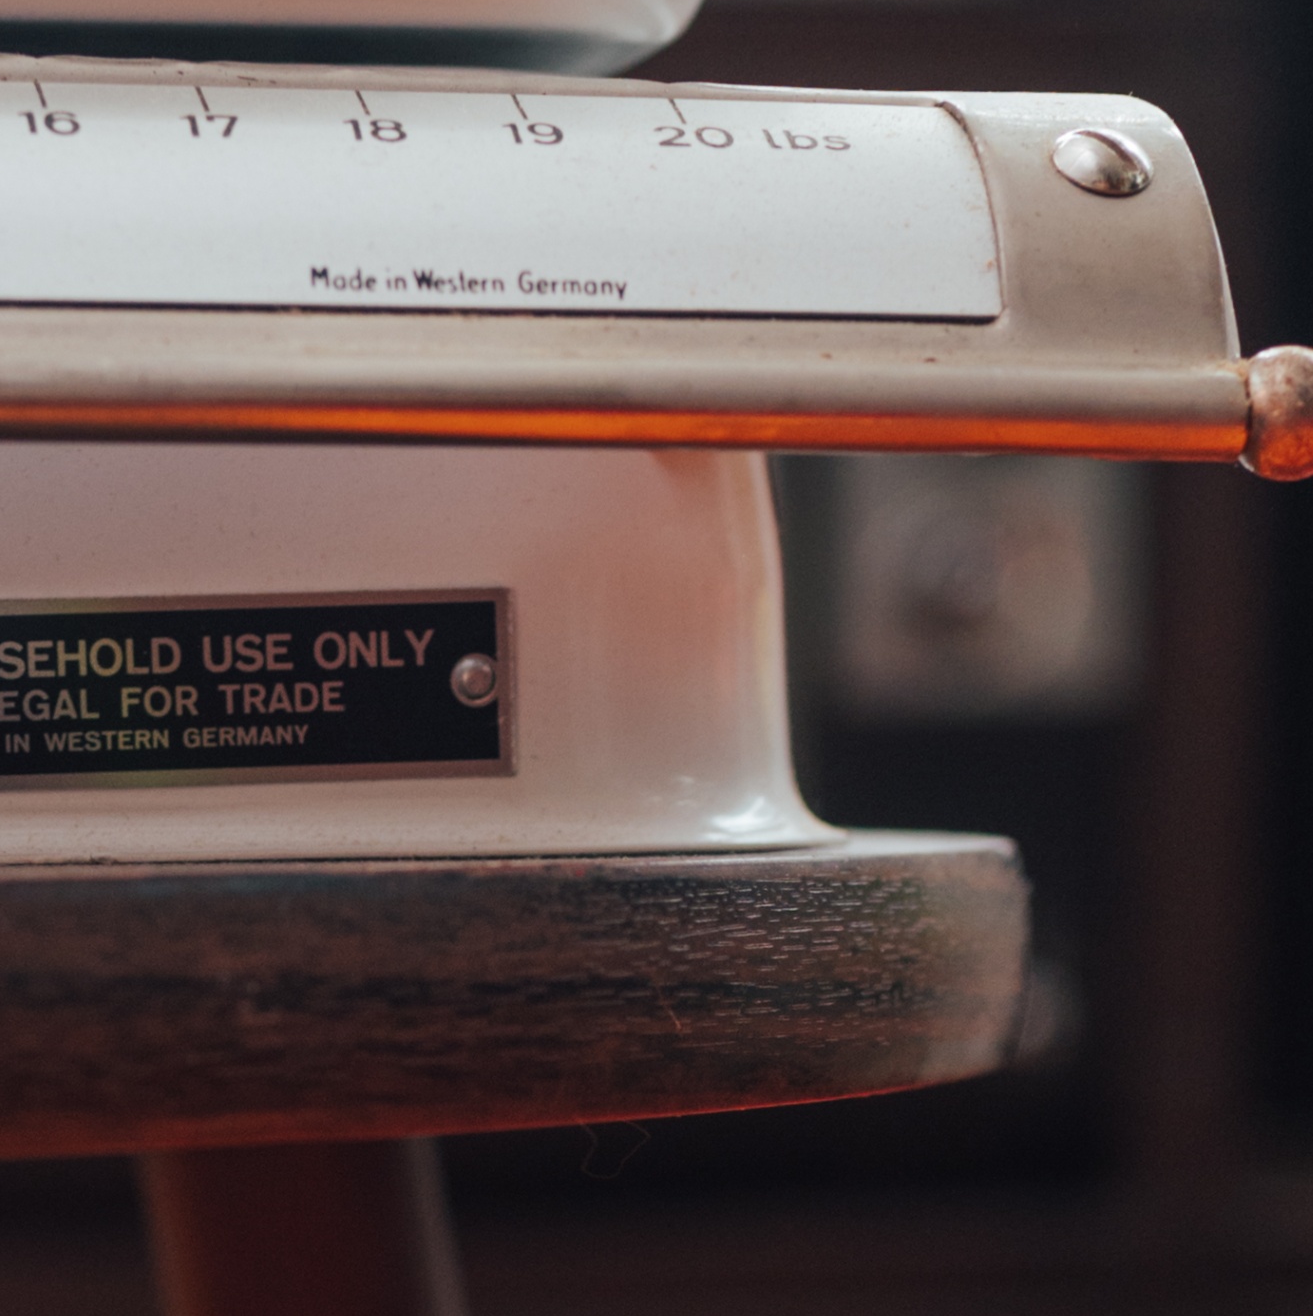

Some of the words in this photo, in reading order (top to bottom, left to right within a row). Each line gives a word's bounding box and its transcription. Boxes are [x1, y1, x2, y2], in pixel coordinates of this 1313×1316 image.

[18, 111, 80, 135] 16
[180, 114, 238, 138] 17
[343, 118, 407, 143] 18
[502, 122, 564, 145] 19
[654, 126, 734, 149] 20
[762, 128, 852, 152] lbs
[310, 267, 377, 291] Made
[384, 271, 409, 291] in
[413, 270, 505, 292] Western
[517, 270, 627, 301] Germany
[202, 633, 294, 673] USE
[313, 629, 434, 670] ONLY
[120, 685, 199, 718] FOR
[217, 680, 345, 715] TRADE
[5, 733, 31, 753] IN
[43, 729, 170, 752] WESTERN
[182, 724, 309, 749] GERMANY
